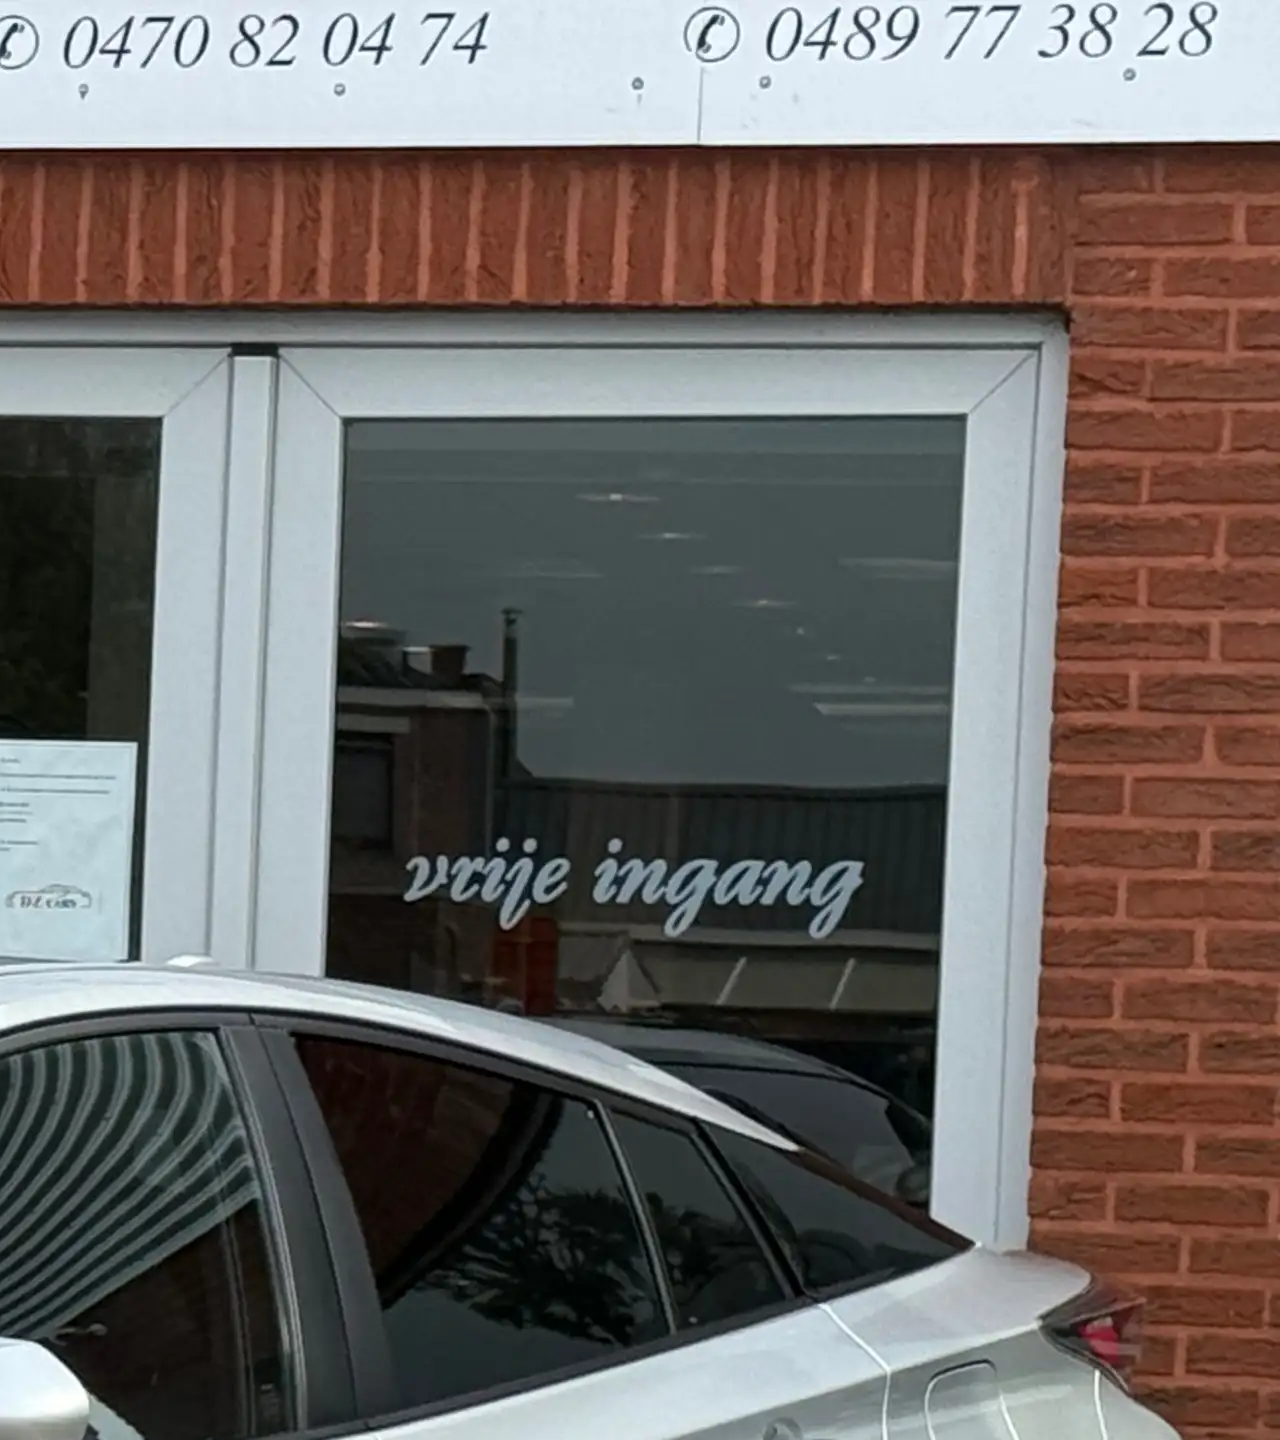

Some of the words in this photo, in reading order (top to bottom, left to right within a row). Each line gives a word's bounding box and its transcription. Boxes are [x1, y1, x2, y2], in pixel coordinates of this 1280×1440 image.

[62, 15, 211, 68] 0470
[227, 14, 300, 67] 82
[321, 13, 395, 66] 04
[419, 12, 489, 66] 74
[765, 7, 920, 61] 0489
[943, 5, 1021, 60] 77
[1037, 3, 1114, 60] 38
[1136, 2, 1218, 58] 28
[402, 837, 572, 931] vrije
[593, 837, 865, 940] ingang
